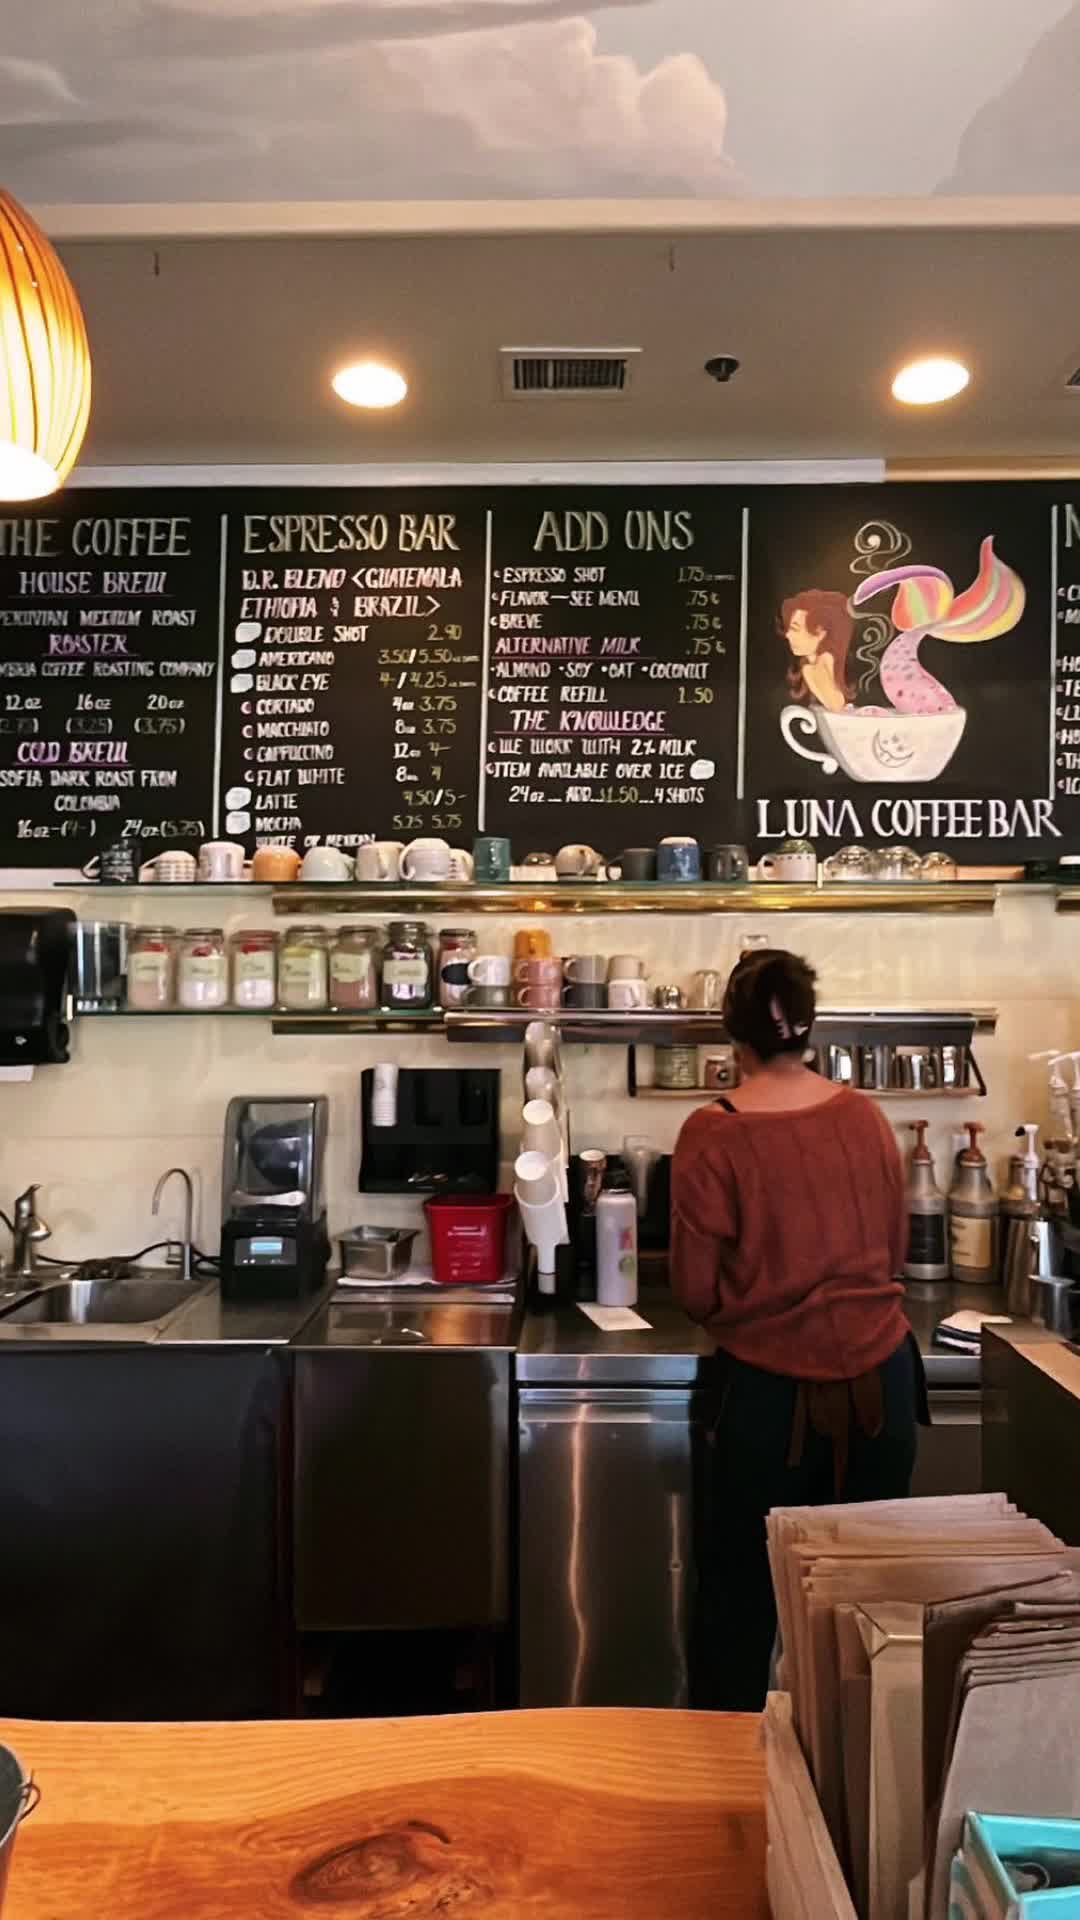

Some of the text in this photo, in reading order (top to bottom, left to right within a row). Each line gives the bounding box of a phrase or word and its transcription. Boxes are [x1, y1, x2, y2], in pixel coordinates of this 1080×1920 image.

[72, 518, 192, 556] COFFEE
[243, 513, 461, 553] ESPRESSO BAR
[533, 510, 695, 551] ADD ONS
[19, 571, 167, 594] HOUSE BREW
[284, 569, 347, 590] BLEND
[503, 567, 606, 583] ESPRESSO SHOT
[240, 597, 318, 619] ETHIOPIA
[599, 591, 640, 607] MENU
[80, 610, 142, 626] MEDIUM
[152, 610, 196, 626] ROAST
[499, 614, 543, 630] BREVE
[264, 625, 370, 644] DOUBLE SHOT
[427, 624, 462, 641] 2.90
[49, 633, 128, 655] ROASTER
[495, 637, 641, 654] ALTERNATIVE MILK
[258, 651, 335, 667] AMERICANO
[41, 661, 86, 677] COFFEE
[93, 661, 154, 677] ROASTING
[159, 661, 215, 677] COMPANY
[256, 673, 331, 691] BLACK EYE
[498, 686, 608, 703] COFFEE REFILL
[679, 686, 713, 704] 1.50
[256, 698, 315, 716] CORTADO
[419, 696, 457, 713] 3.75
[257, 721, 330, 738] MACCHIATO
[421, 718, 457, 735] 3.75
[509, 709, 666, 732] THE KNOWLEDGE
[17, 741, 128, 763] COLD BREW
[256, 745, 334, 763] CAPPUCCINO
[499, 737, 697, 756] WE WORK WITH 2% MILK
[50, 770, 90, 787] DARK
[95, 770, 135, 787] ROAST
[140, 770, 178, 787] FROM
[257, 768, 346, 787] FLAT WHITE
[493, 762, 684, 780] ITEM AVAILABLE OVER ICE
[54, 795, 120, 811] COLOMBIA
[255, 793, 298, 810] LATTE
[666, 786, 705, 803] SHOTS
[255, 816, 302, 832] MOCHA
[757, 799, 1063, 838] LUNA COFFEE BAR
